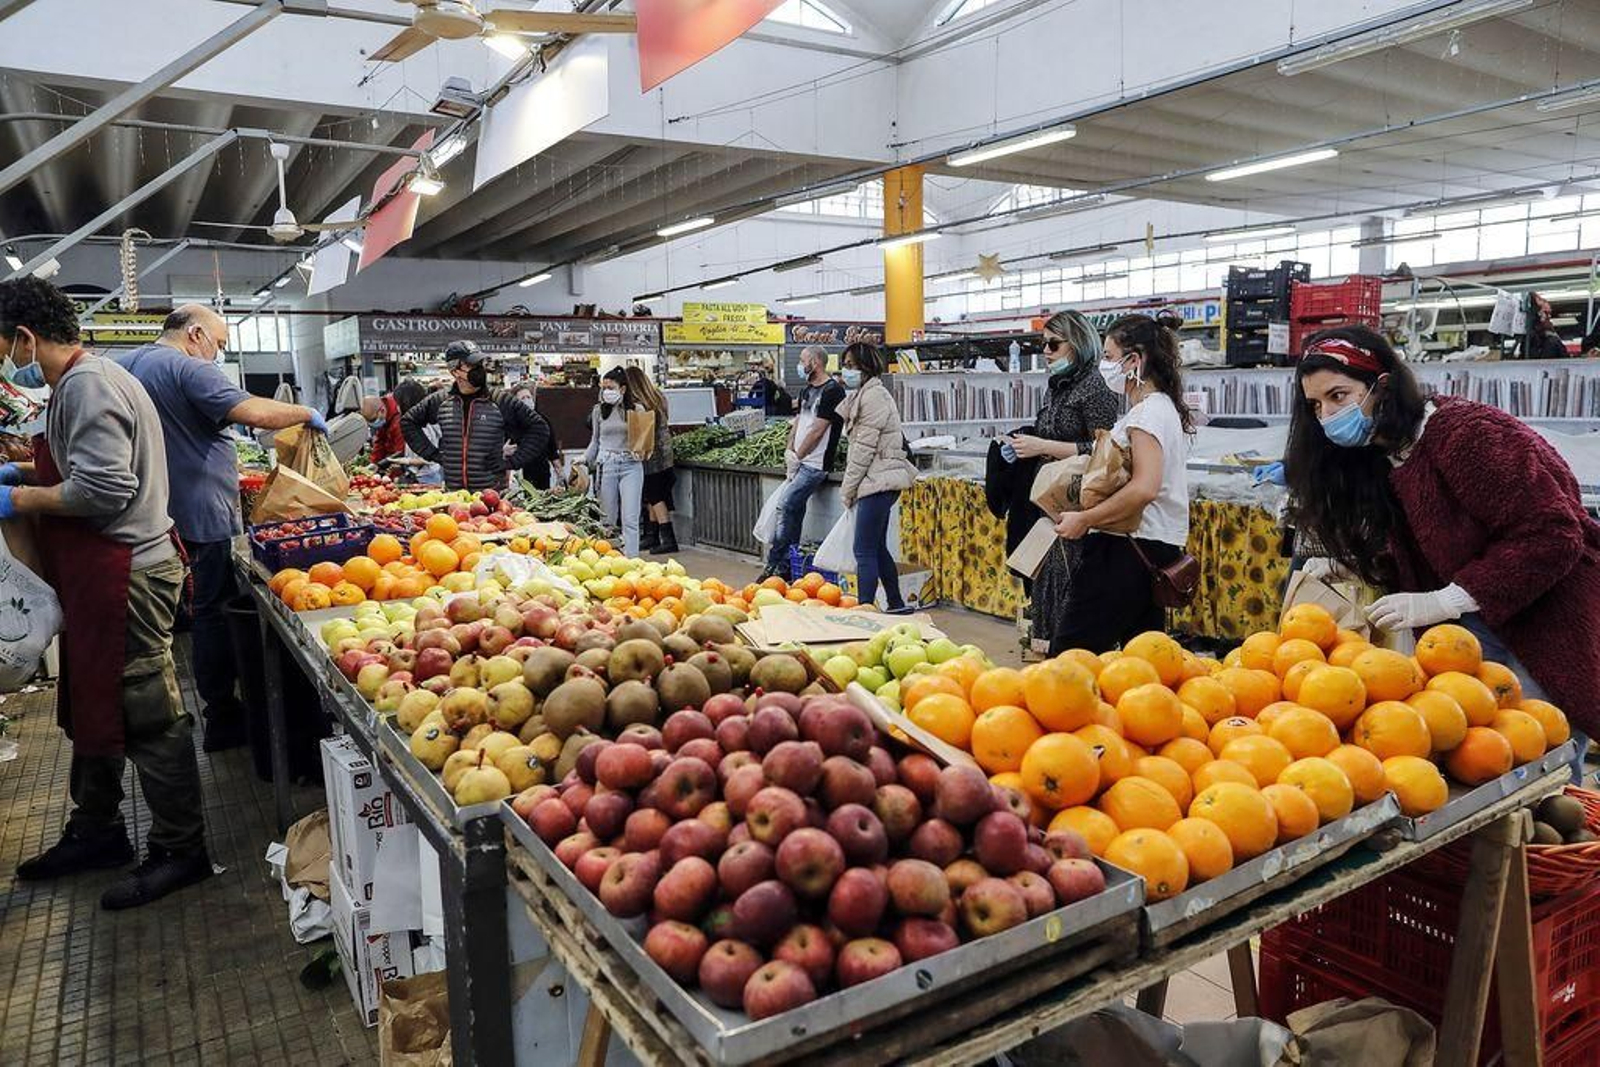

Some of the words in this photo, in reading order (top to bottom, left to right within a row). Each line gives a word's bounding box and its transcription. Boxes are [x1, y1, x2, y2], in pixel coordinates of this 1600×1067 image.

[112, 319, 165, 337] FRES
[372, 318, 487, 332] GASTRONOMIA
[539, 321, 571, 331] PANE
[591, 321, 659, 333] SALUMERIA
[520, 343, 556, 352] BUFALA
[367, 797, 385, 830] Bio
